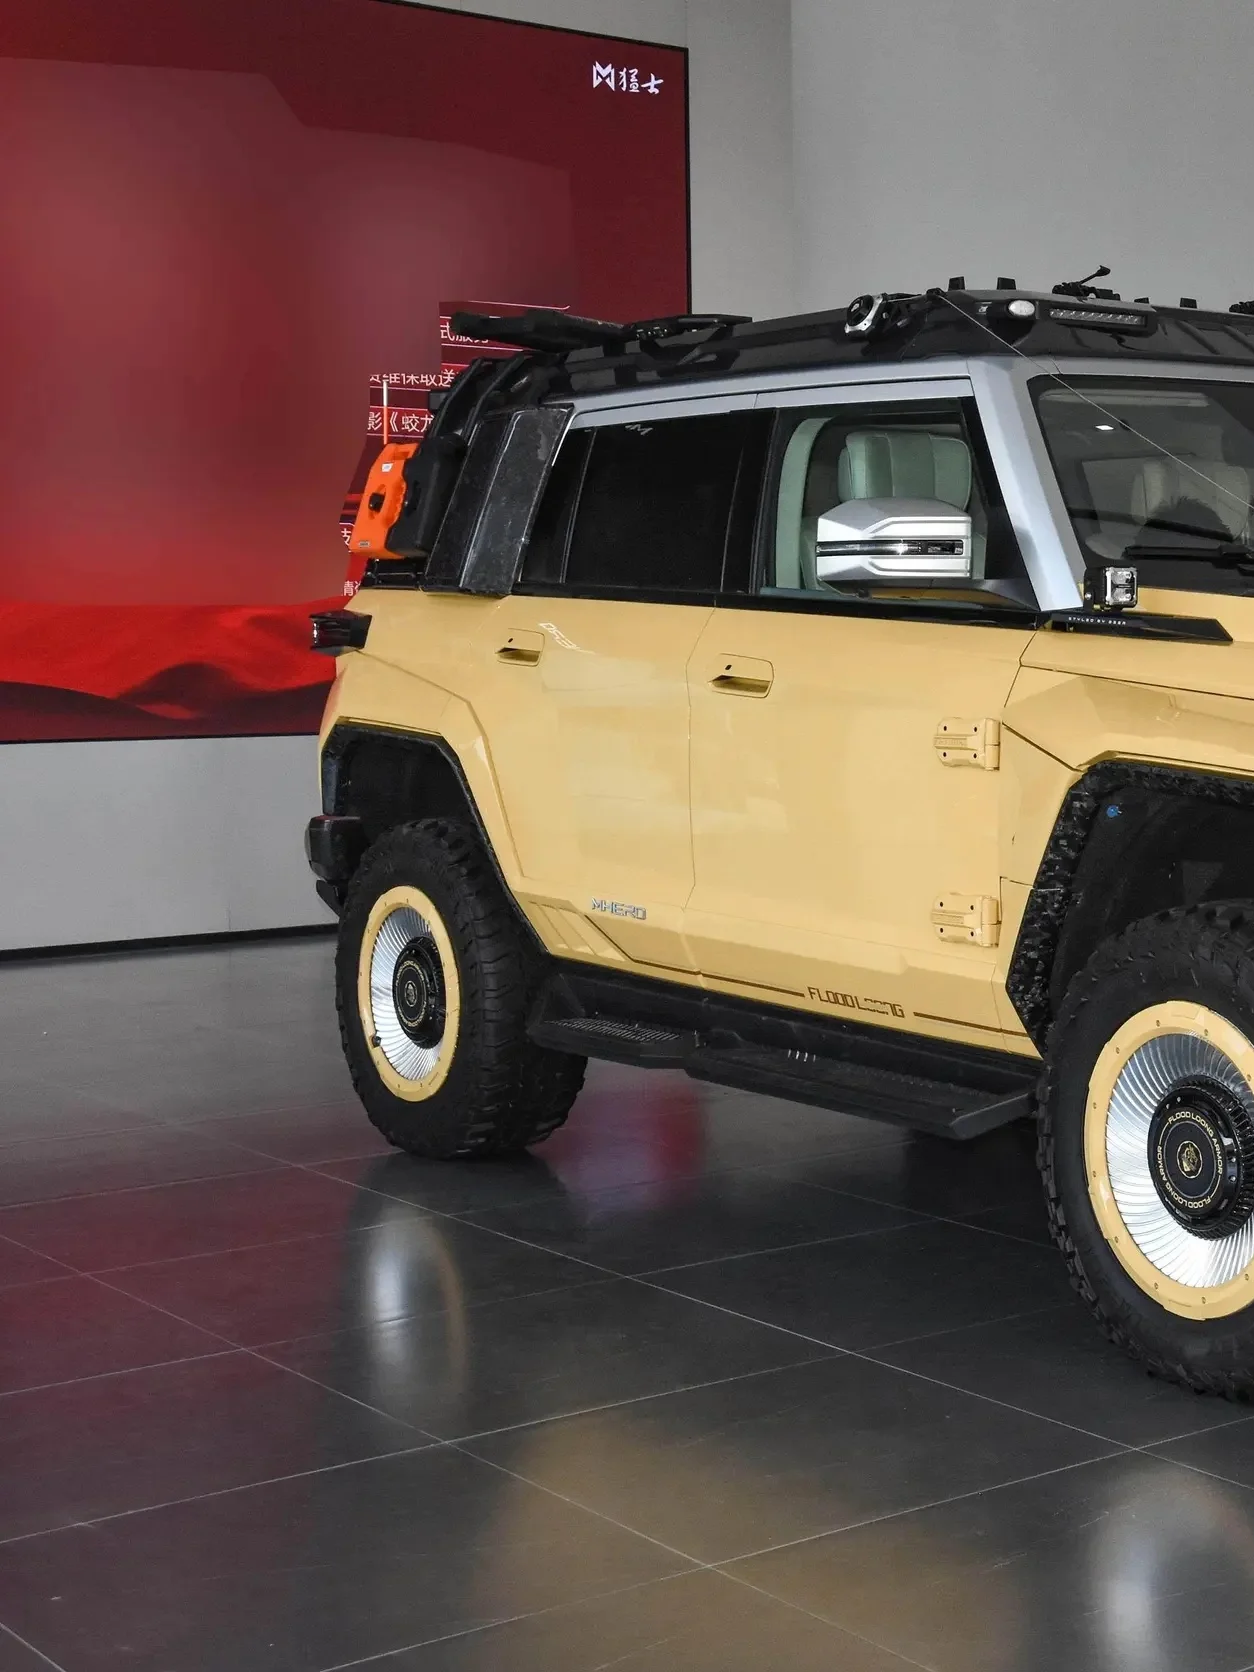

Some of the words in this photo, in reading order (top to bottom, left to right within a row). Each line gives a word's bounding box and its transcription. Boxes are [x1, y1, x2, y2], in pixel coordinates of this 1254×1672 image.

[591, 897, 646, 920] MHERO
[1168, 1111, 1191, 1124] FLOOD
[1191, 1113, 1214, 1137] LOONG
[1212, 1138, 1223, 1174] ARMOR
[1157, 1146, 1167, 1181] ARMOR
[1165, 1182, 1188, 1206] LOONG
[1188, 1196, 1211, 1208] FLOOD
